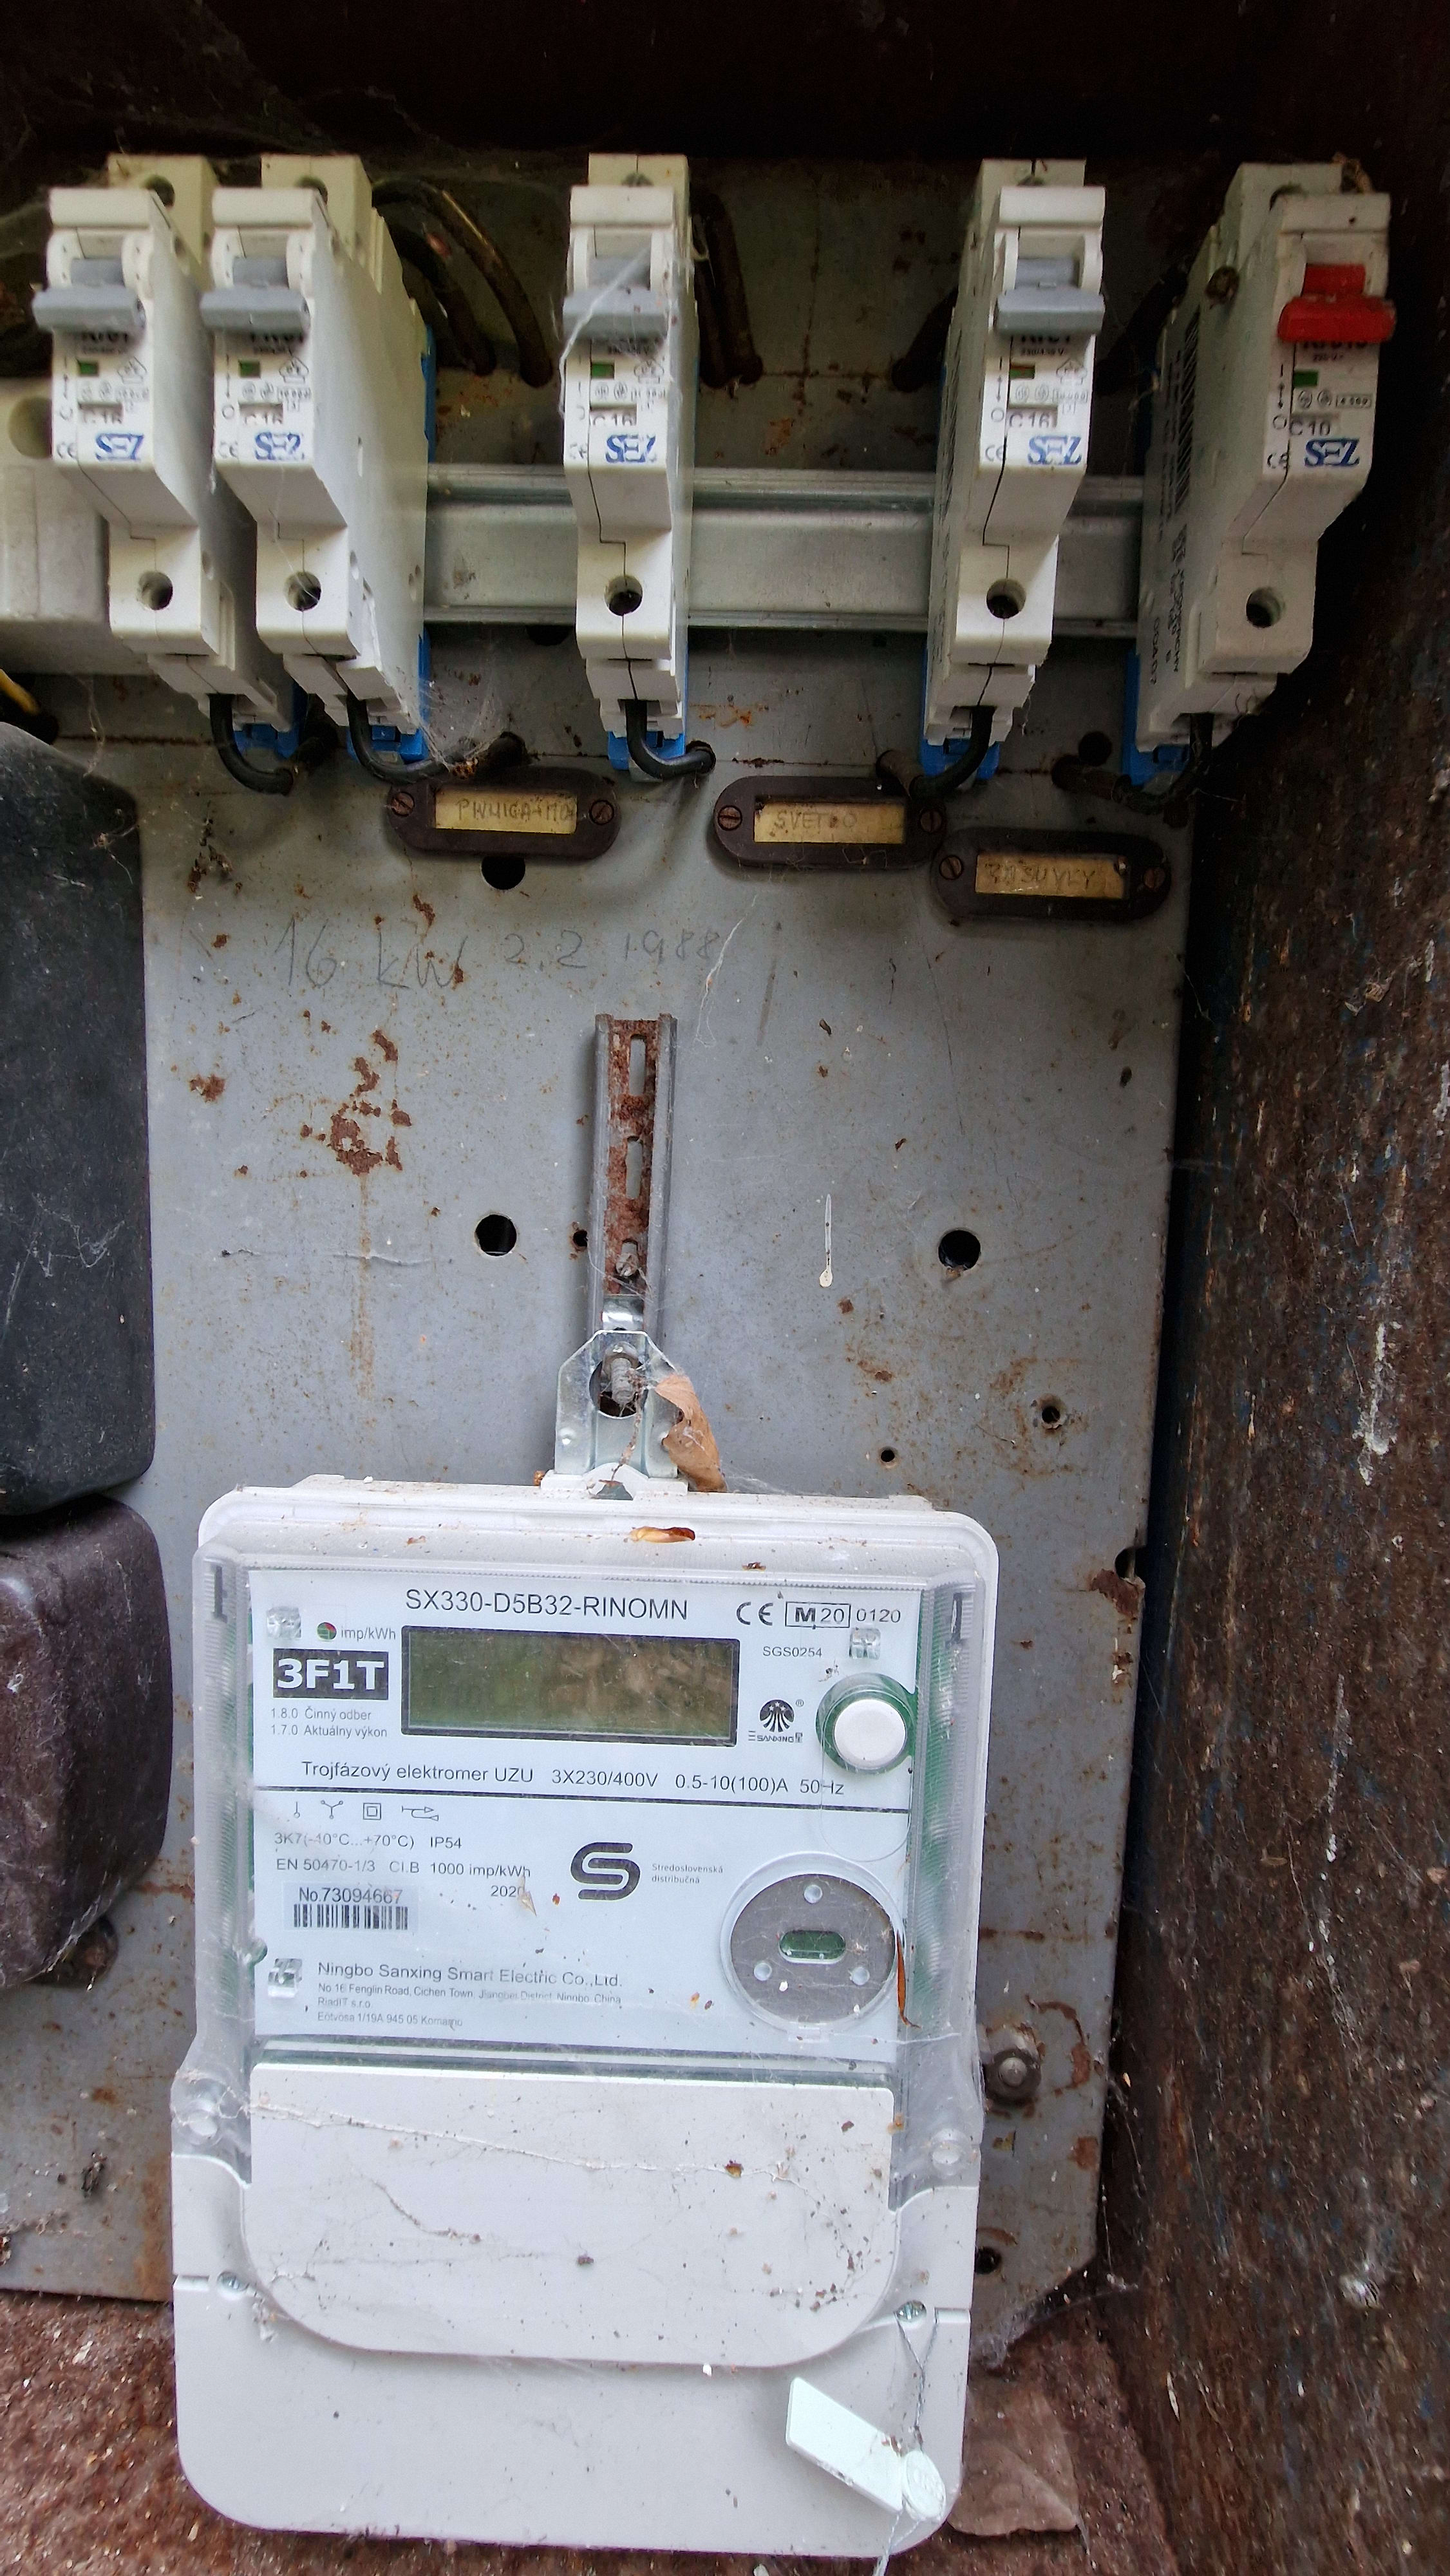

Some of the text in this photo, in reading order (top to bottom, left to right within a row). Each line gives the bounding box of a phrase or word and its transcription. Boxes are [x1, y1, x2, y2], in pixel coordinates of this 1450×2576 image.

[1027, 434, 1082, 466] SEZ
[1303, 437, 1361, 468] SEZ
[774, 810, 858, 830] SVETO
[274, 918, 339, 988] 16
[623, 929, 721, 965] 1988
[405, 1588, 689, 1621] SX330-D5B32-RINOMN
[856, 1607, 901, 1624] 0120
[340, 1625, 397, 1642] imp/kWh
[762, 1645, 823, 1658] SGS0254
[276, 1657, 385, 1691] 3F1T
[270, 1704, 372, 1721] 1.8.0 Činný odber
[270, 1724, 388, 1739] 1.7.0 Aktuálny výkon
[301, 1761, 391, 1782] Trojfázový
[396, 1764, 489, 1783] elektromer
[494, 1767, 534, 1783] UZU
[551, 1768, 658, 1788] 3X230/400V
[675, 1772, 789, 1794] 0.5-10(100)A
[429, 1835, 462, 1850] IP54
[276, 1858, 298, 1871] EN
[303, 1859, 376, 1873] 50470-1/3
[429, 1862, 464, 1876] 1000
[469, 1863, 531, 1879] imp/kWh
[652, 1863, 724, 1874] Stredoslovenská
[317, 1961, 374, 1978] Ningbo
[379, 1964, 442, 1982] Sanxing
[447, 1966, 494, 1982] Smart
[499, 1969, 558, 1985] Electric
[348, 1984, 383, 1997] Fenglin
[357, 2013, 384, 2023] 1/19A
[386, 2014, 404, 2024] 945
[406, 2015, 419, 2024] 05
